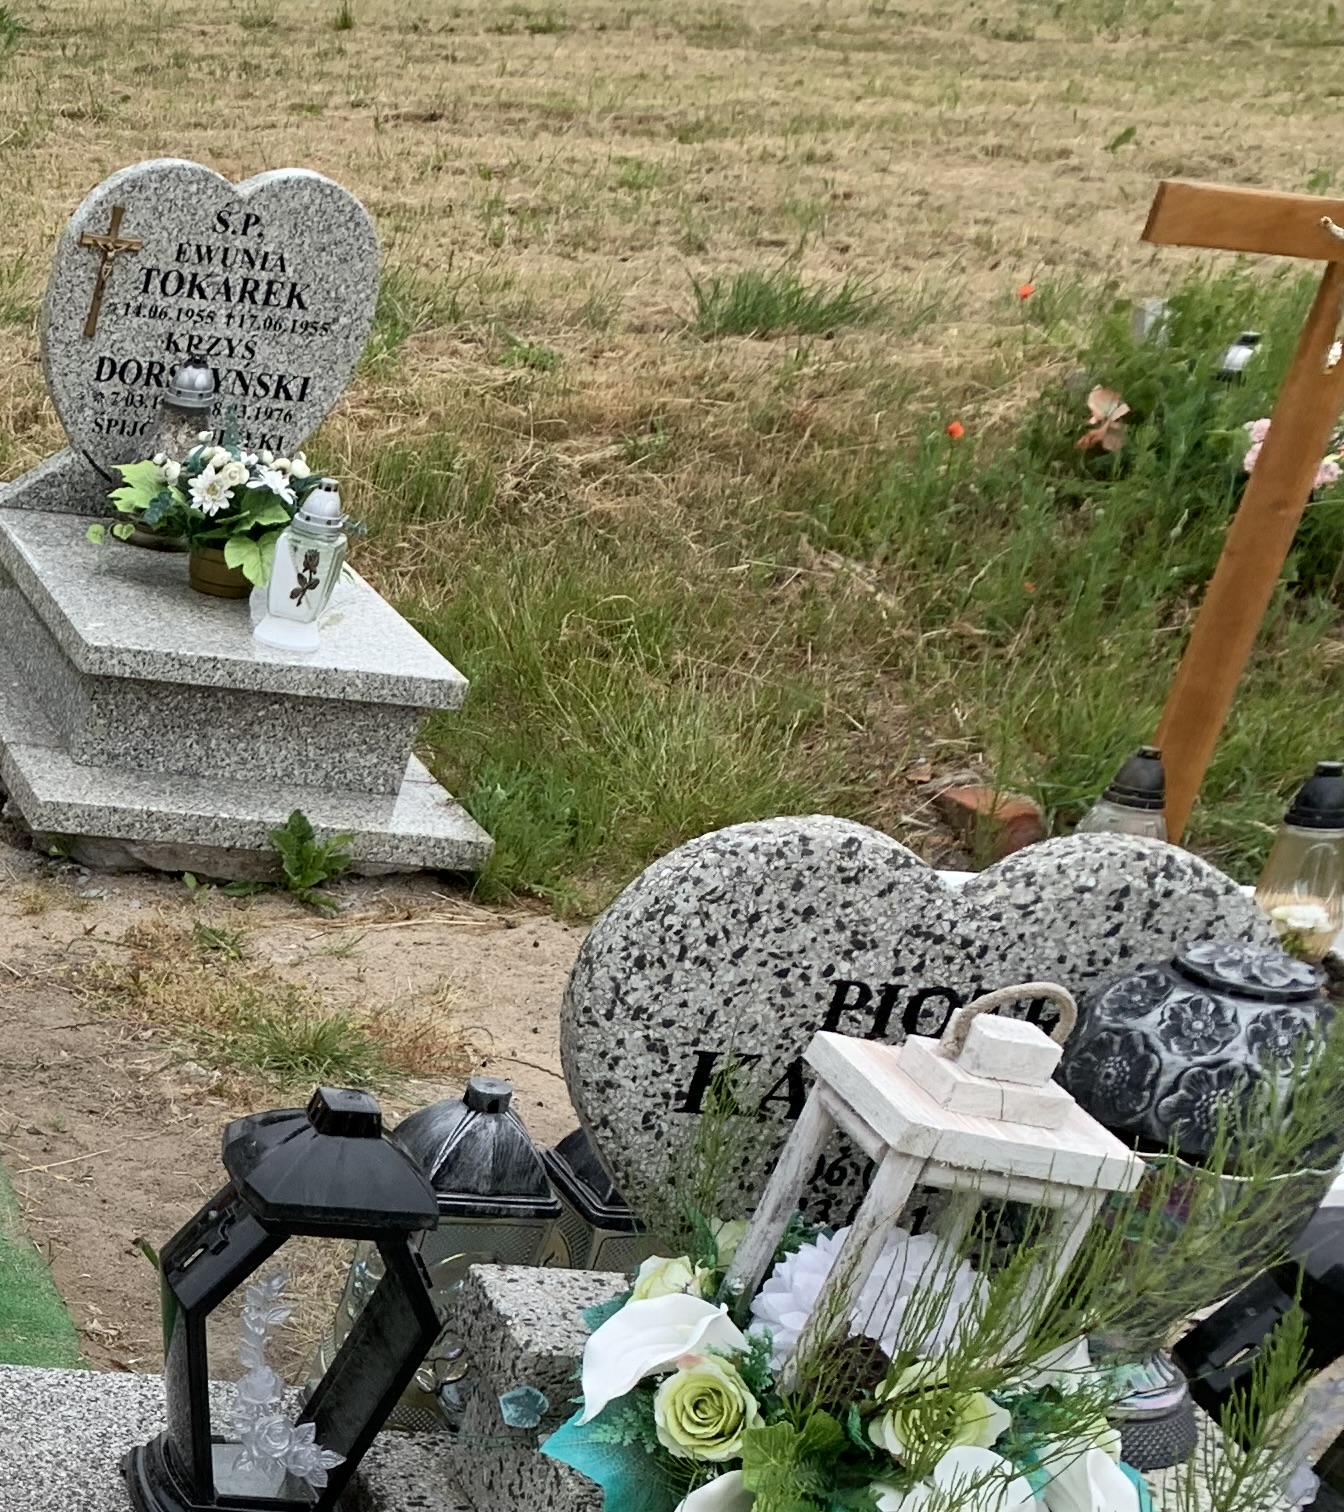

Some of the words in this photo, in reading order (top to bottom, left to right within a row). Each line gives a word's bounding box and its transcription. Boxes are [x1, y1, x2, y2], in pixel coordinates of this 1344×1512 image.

[175, 242, 287, 273] EWUNIA
[140, 266, 311, 311] TOKAREK
[165, 331, 257, 360] KRZYŚ
[95, 355, 311, 403] DORYŃSKI
[814, 979, 1062, 1040] PIO
